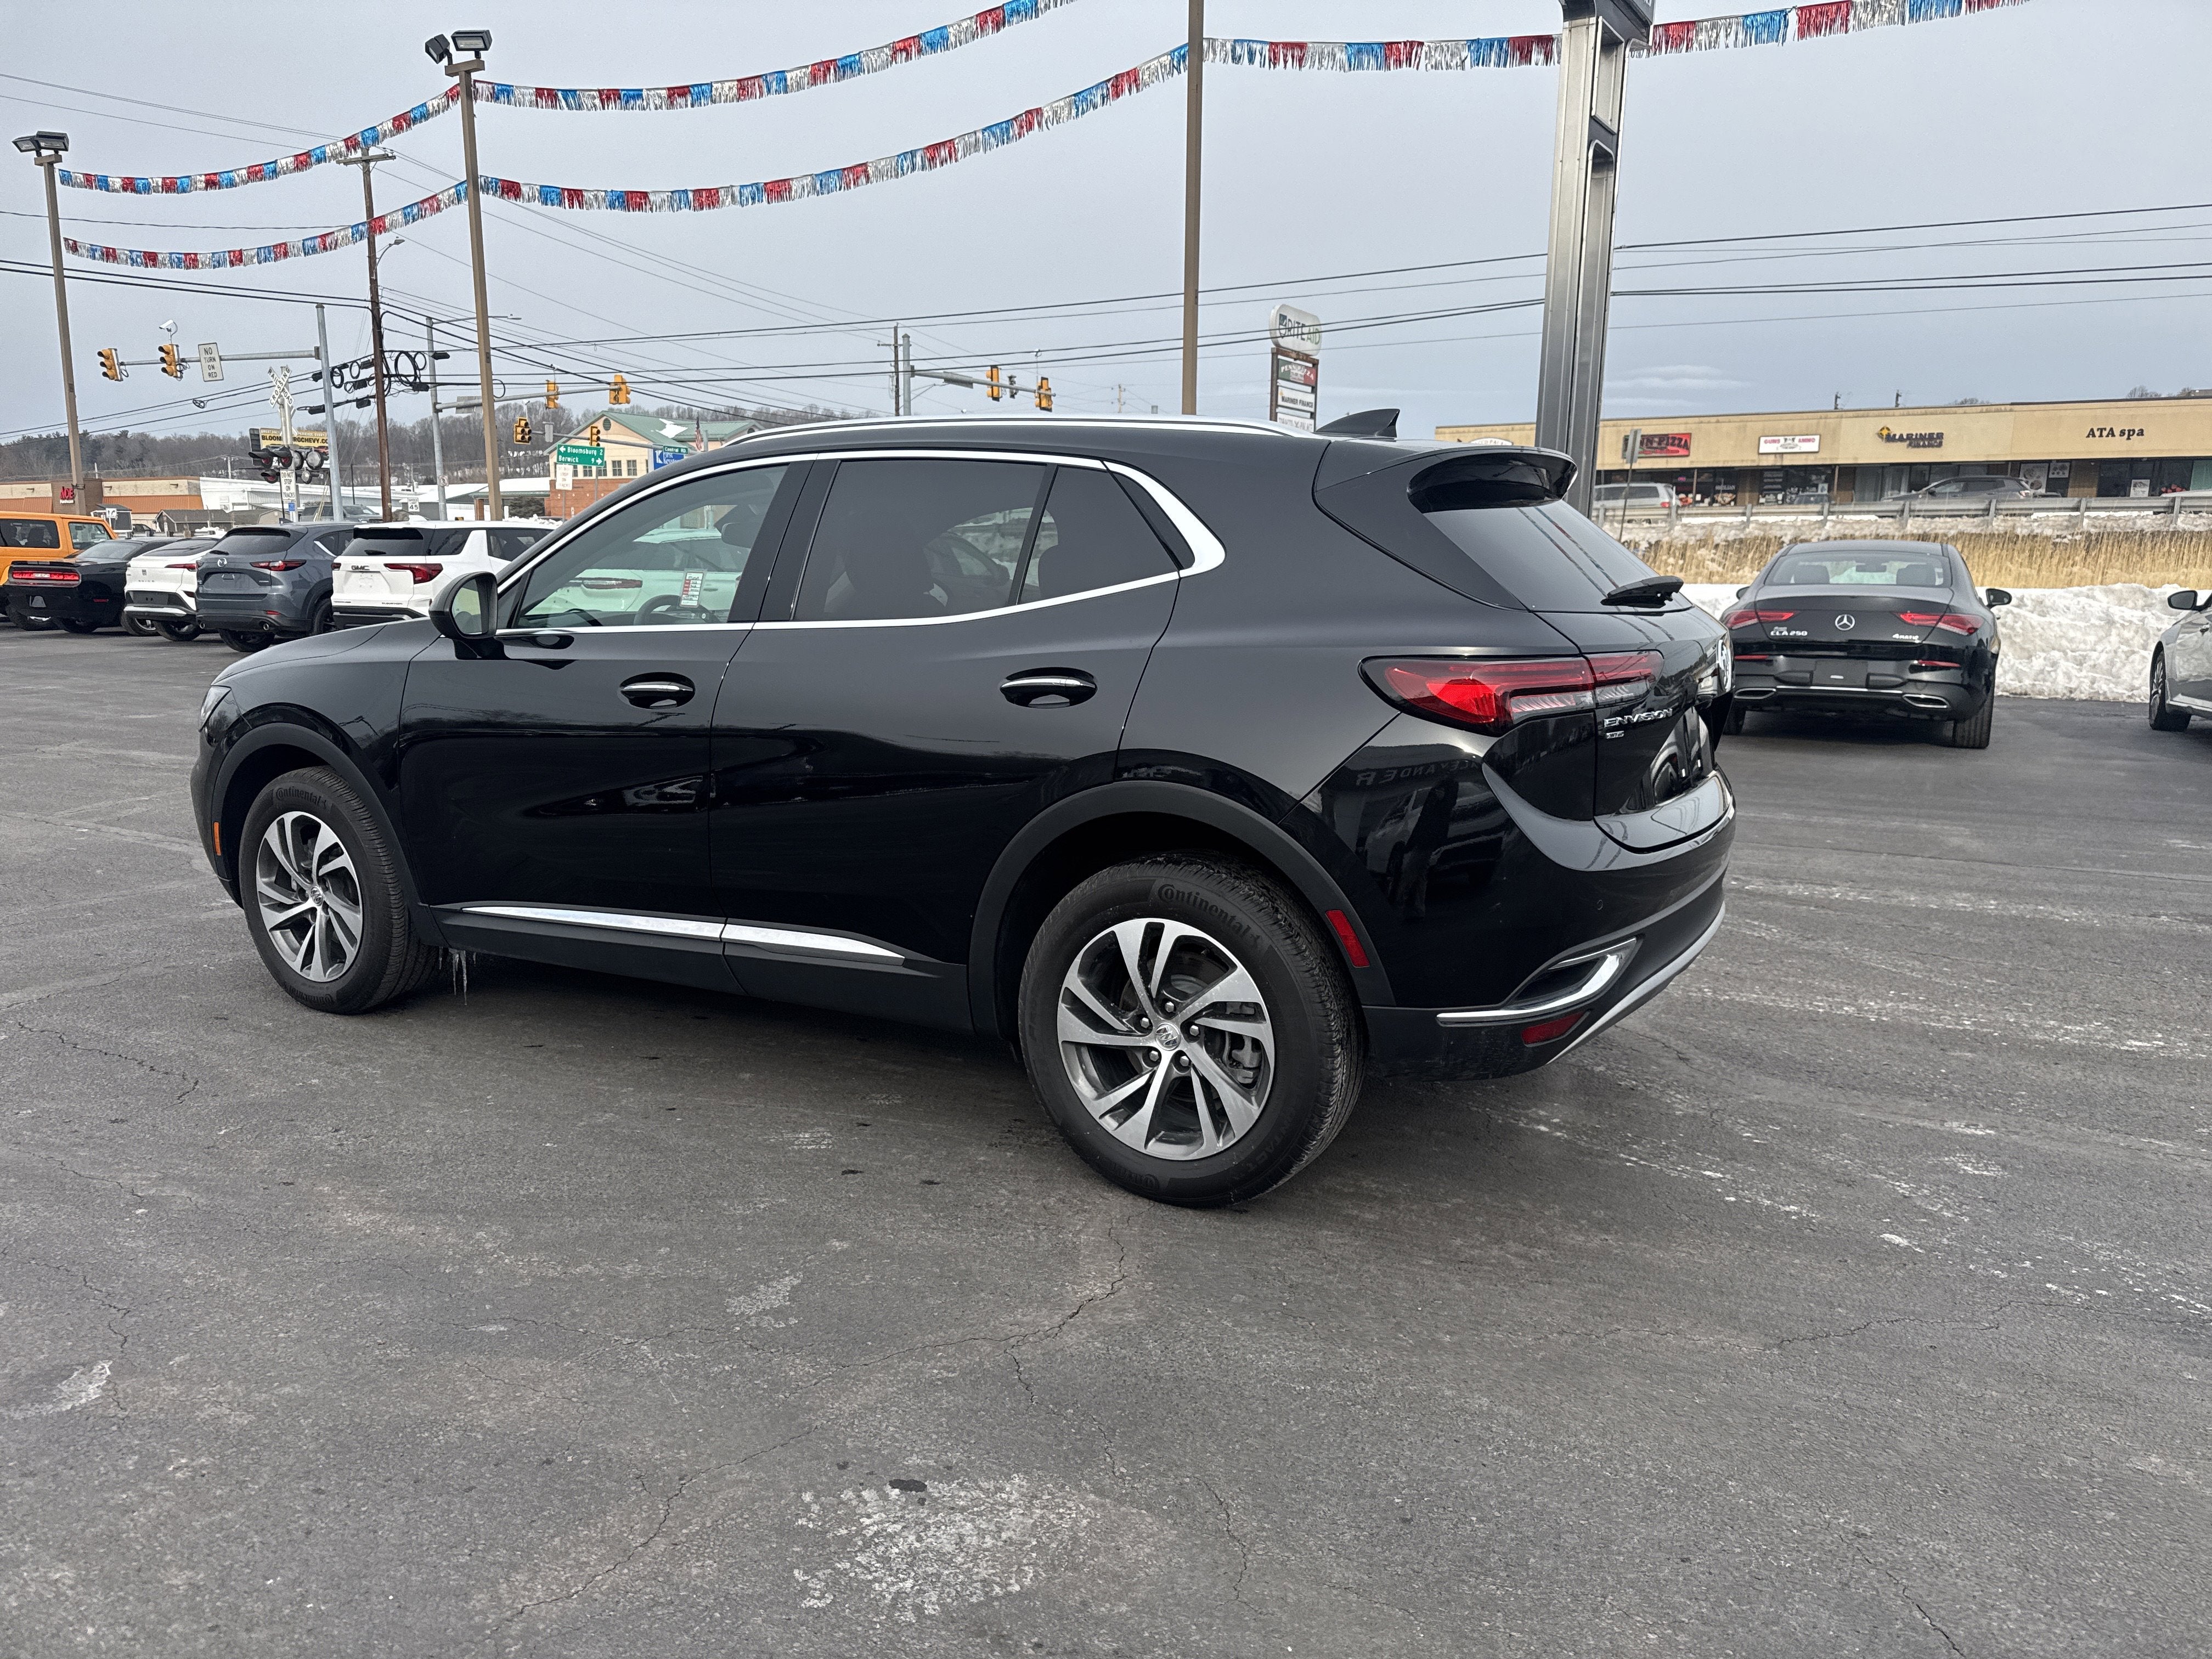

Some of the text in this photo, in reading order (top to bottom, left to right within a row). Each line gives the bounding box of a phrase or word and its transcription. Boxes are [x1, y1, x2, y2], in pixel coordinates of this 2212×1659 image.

[1287, 319, 1321, 345] RITE AID
[204, 347, 213, 356] NO
[268, 368, 292, 404] RAILROAD
[269, 367, 290, 405] CROSSING
[261, 435, 329, 444] BLOOMRGCHEVY.CO
[1885, 432, 1944, 443] MARINER
[2085, 427, 2145, 441] ATA spa
[1658, 436, 1689, 450] PIZZA
[567, 447, 597, 456] Bloomsburg
[558, 455, 579, 463] Berwick
[59, 487, 74, 499] ACE
[1604, 708, 1673, 728] ENVISION
[275, 786, 322, 806] Continental
[1158, 883, 1251, 939] Continental
